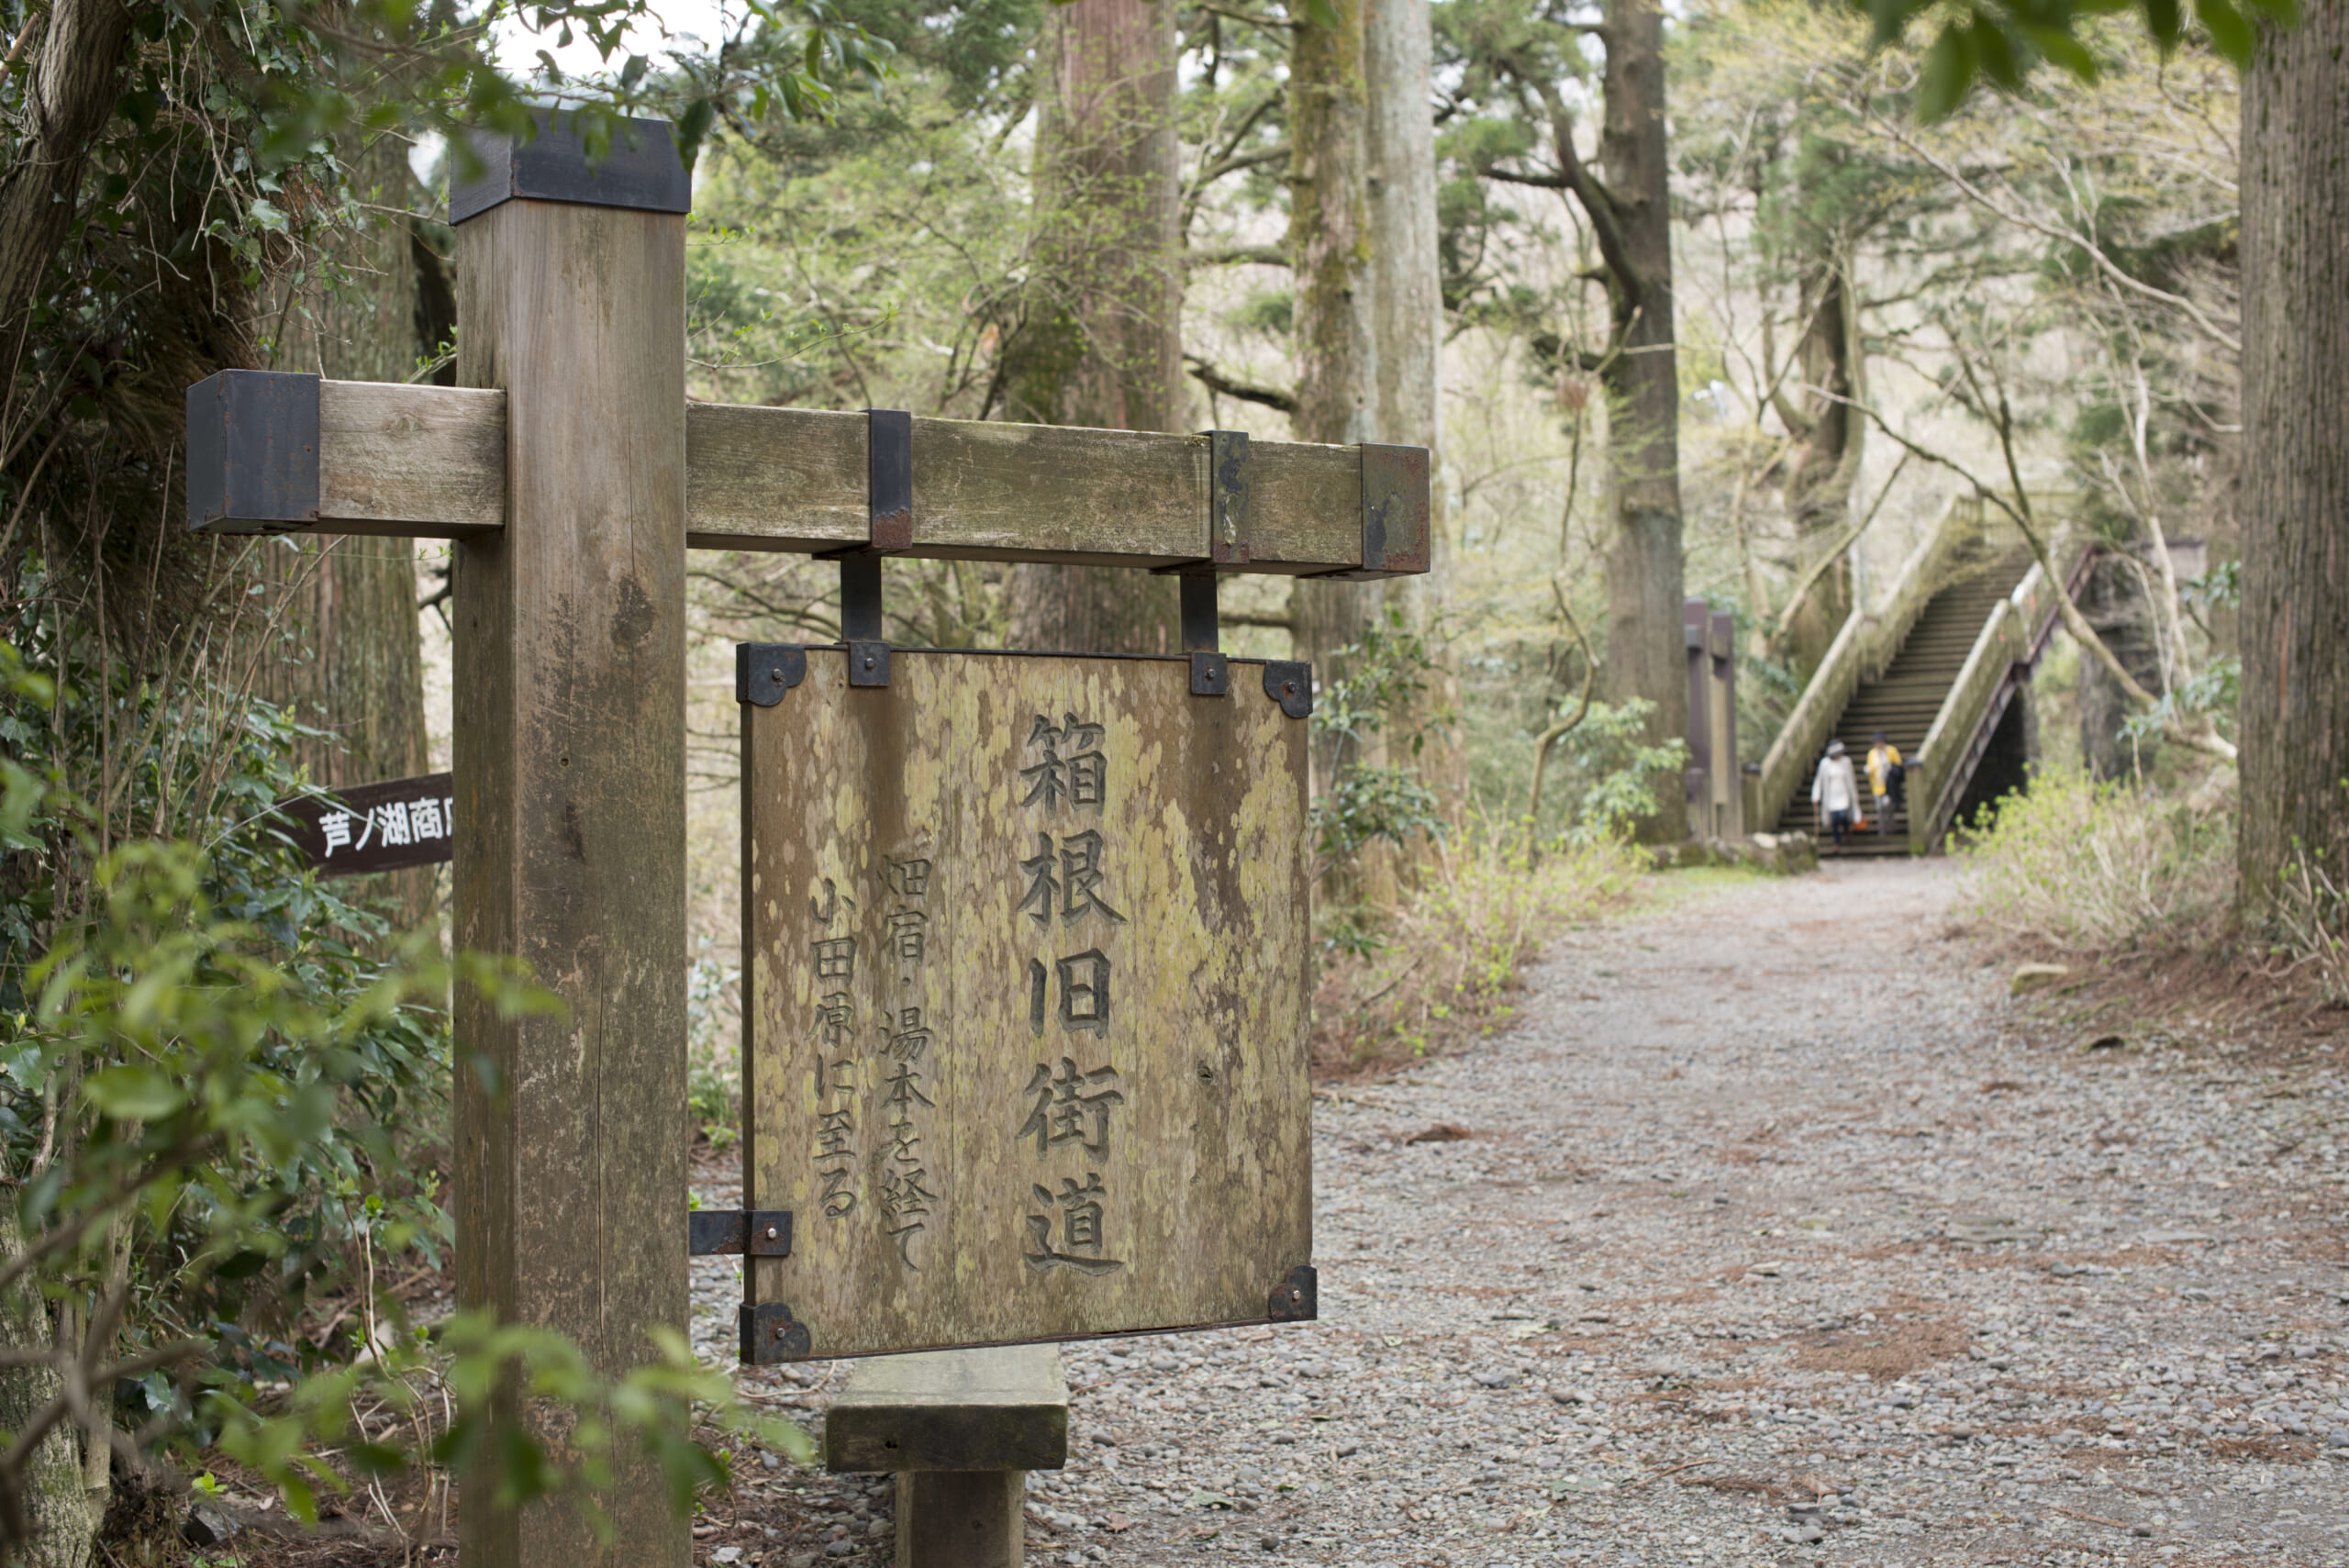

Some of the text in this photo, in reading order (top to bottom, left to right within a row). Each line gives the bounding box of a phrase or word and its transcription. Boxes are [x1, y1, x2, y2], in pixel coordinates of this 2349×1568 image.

[805, 877, 858, 1220] 小田原に至る
[876, 853, 939, 1273] 畑宿・湯本を経て
[1017, 711, 1128, 1277] 箱根旧街道
